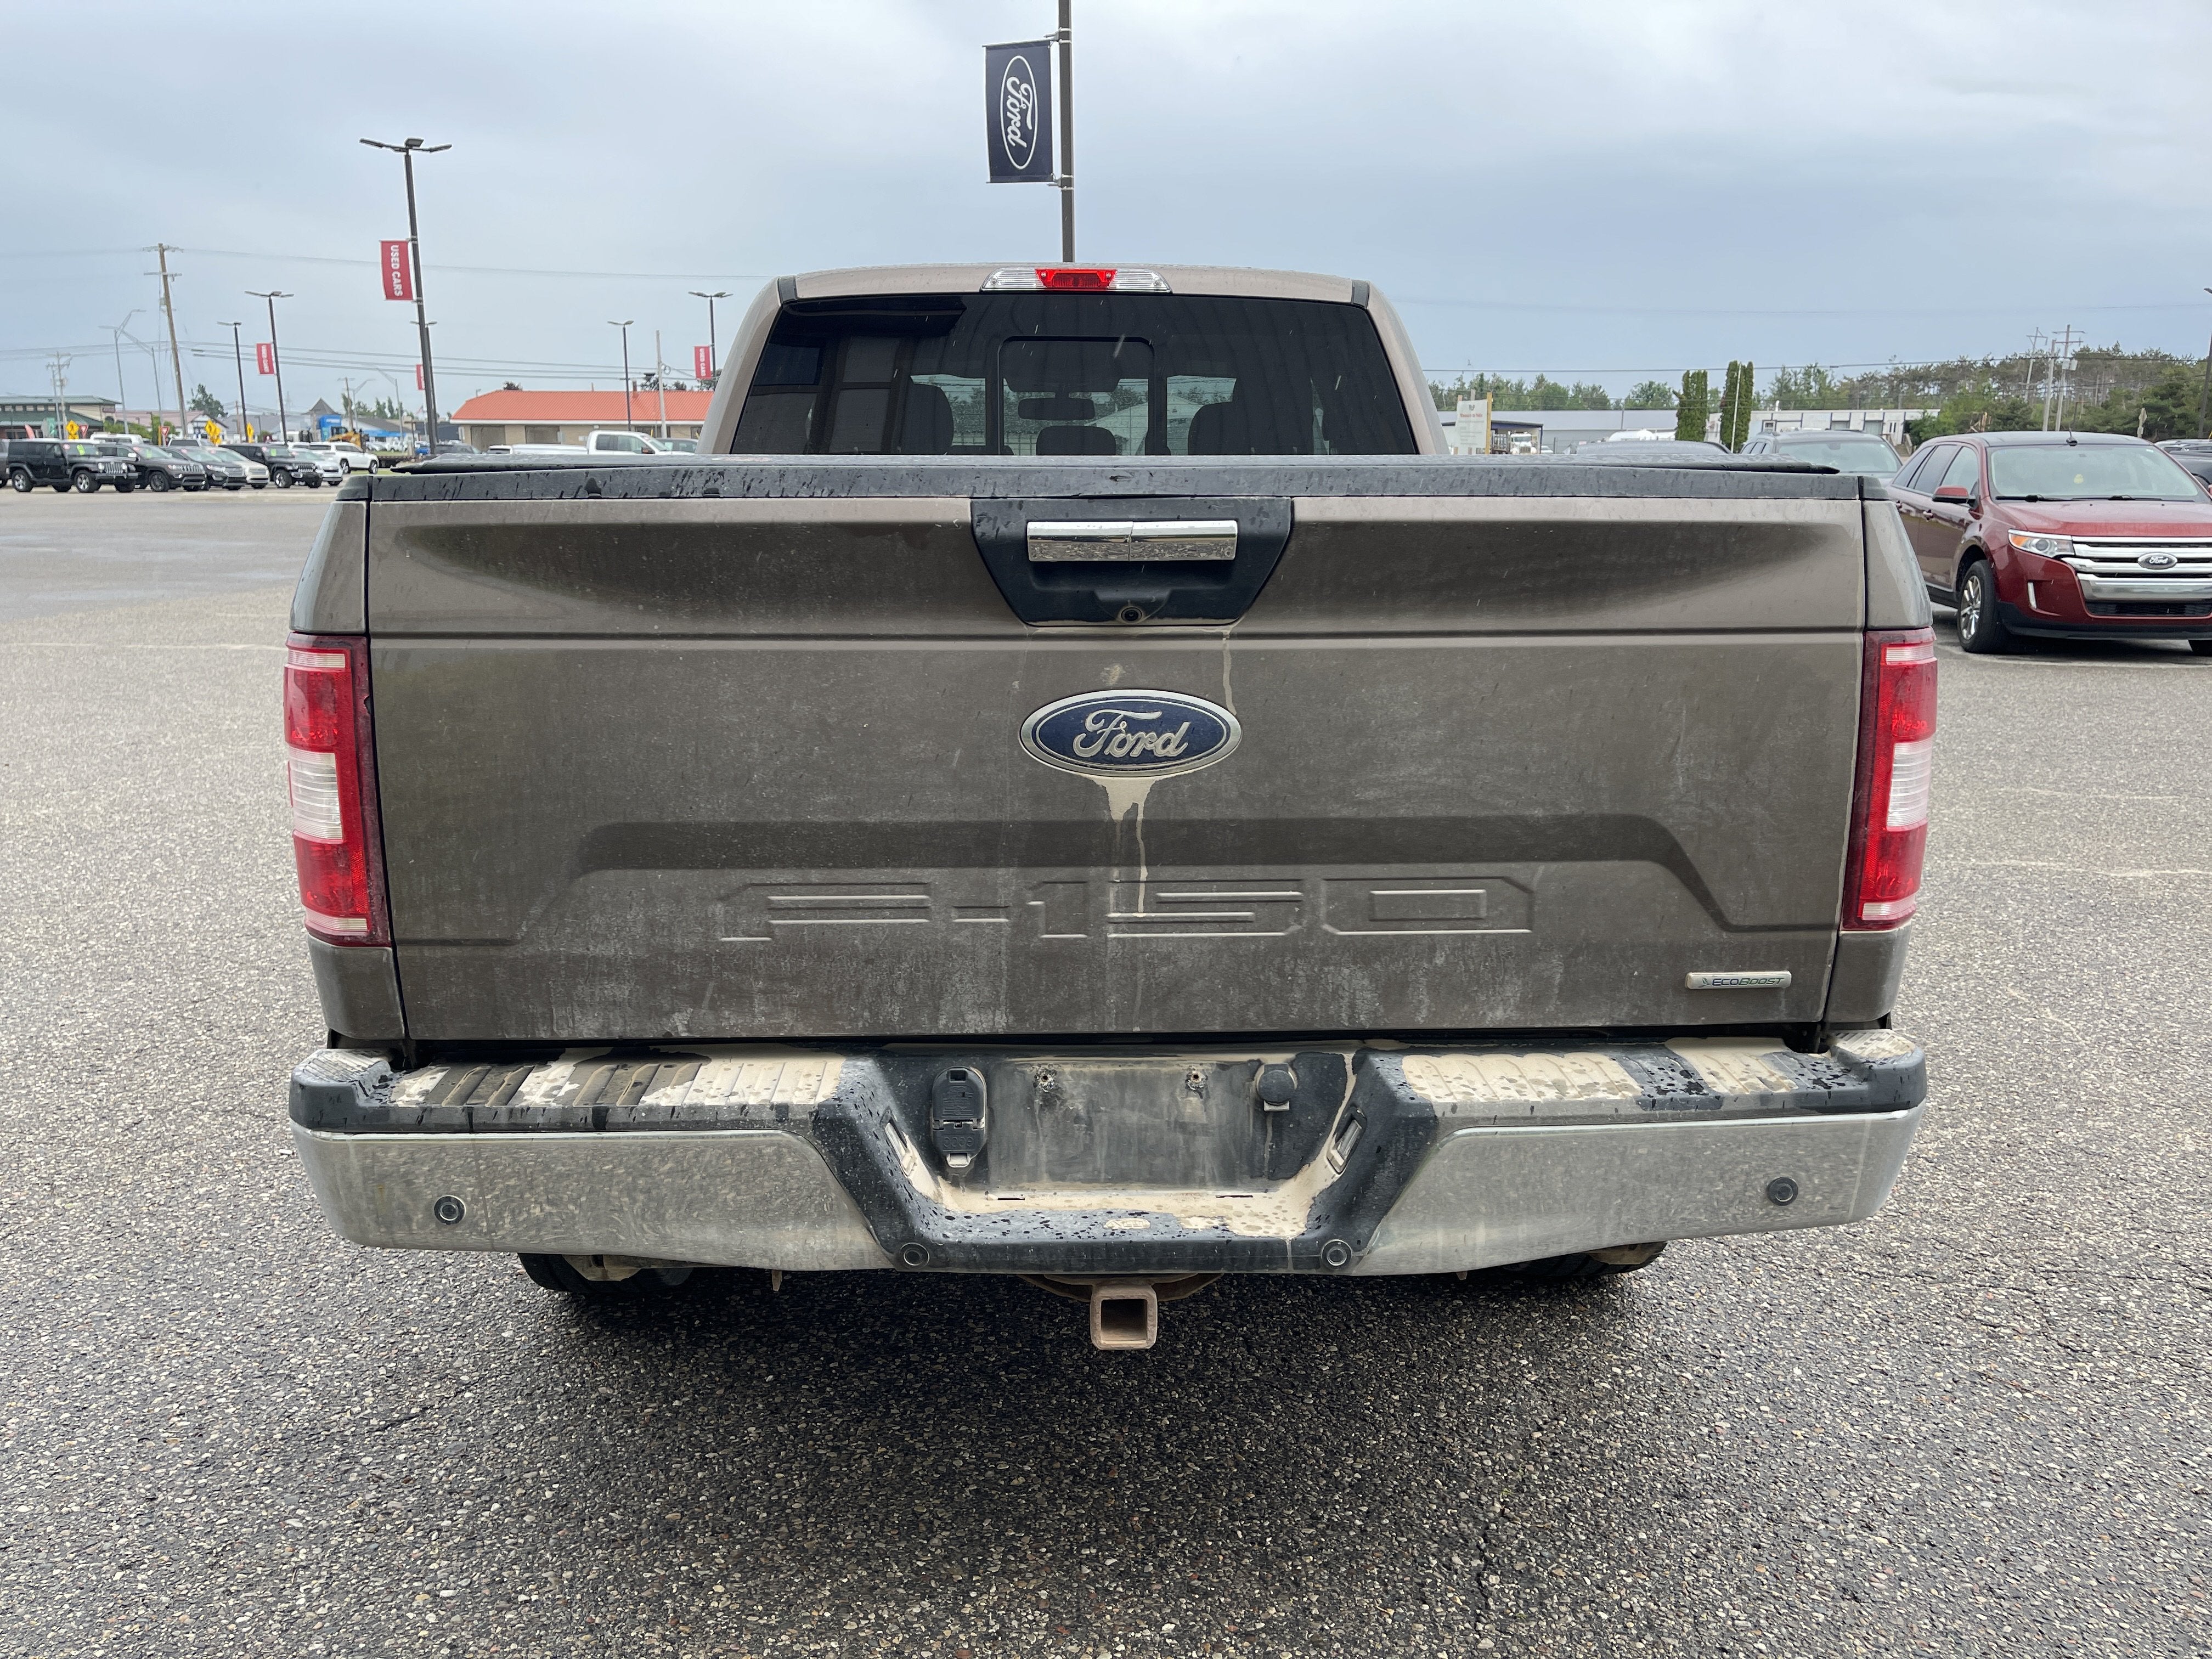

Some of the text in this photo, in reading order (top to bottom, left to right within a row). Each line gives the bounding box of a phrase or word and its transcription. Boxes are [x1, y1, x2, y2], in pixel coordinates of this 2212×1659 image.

[1006, 76, 1033, 148] Ford
[390, 245, 403, 297] USED CARS
[2149, 556, 2169, 564] Ford
[1073, 709, 1191, 758] Ford
